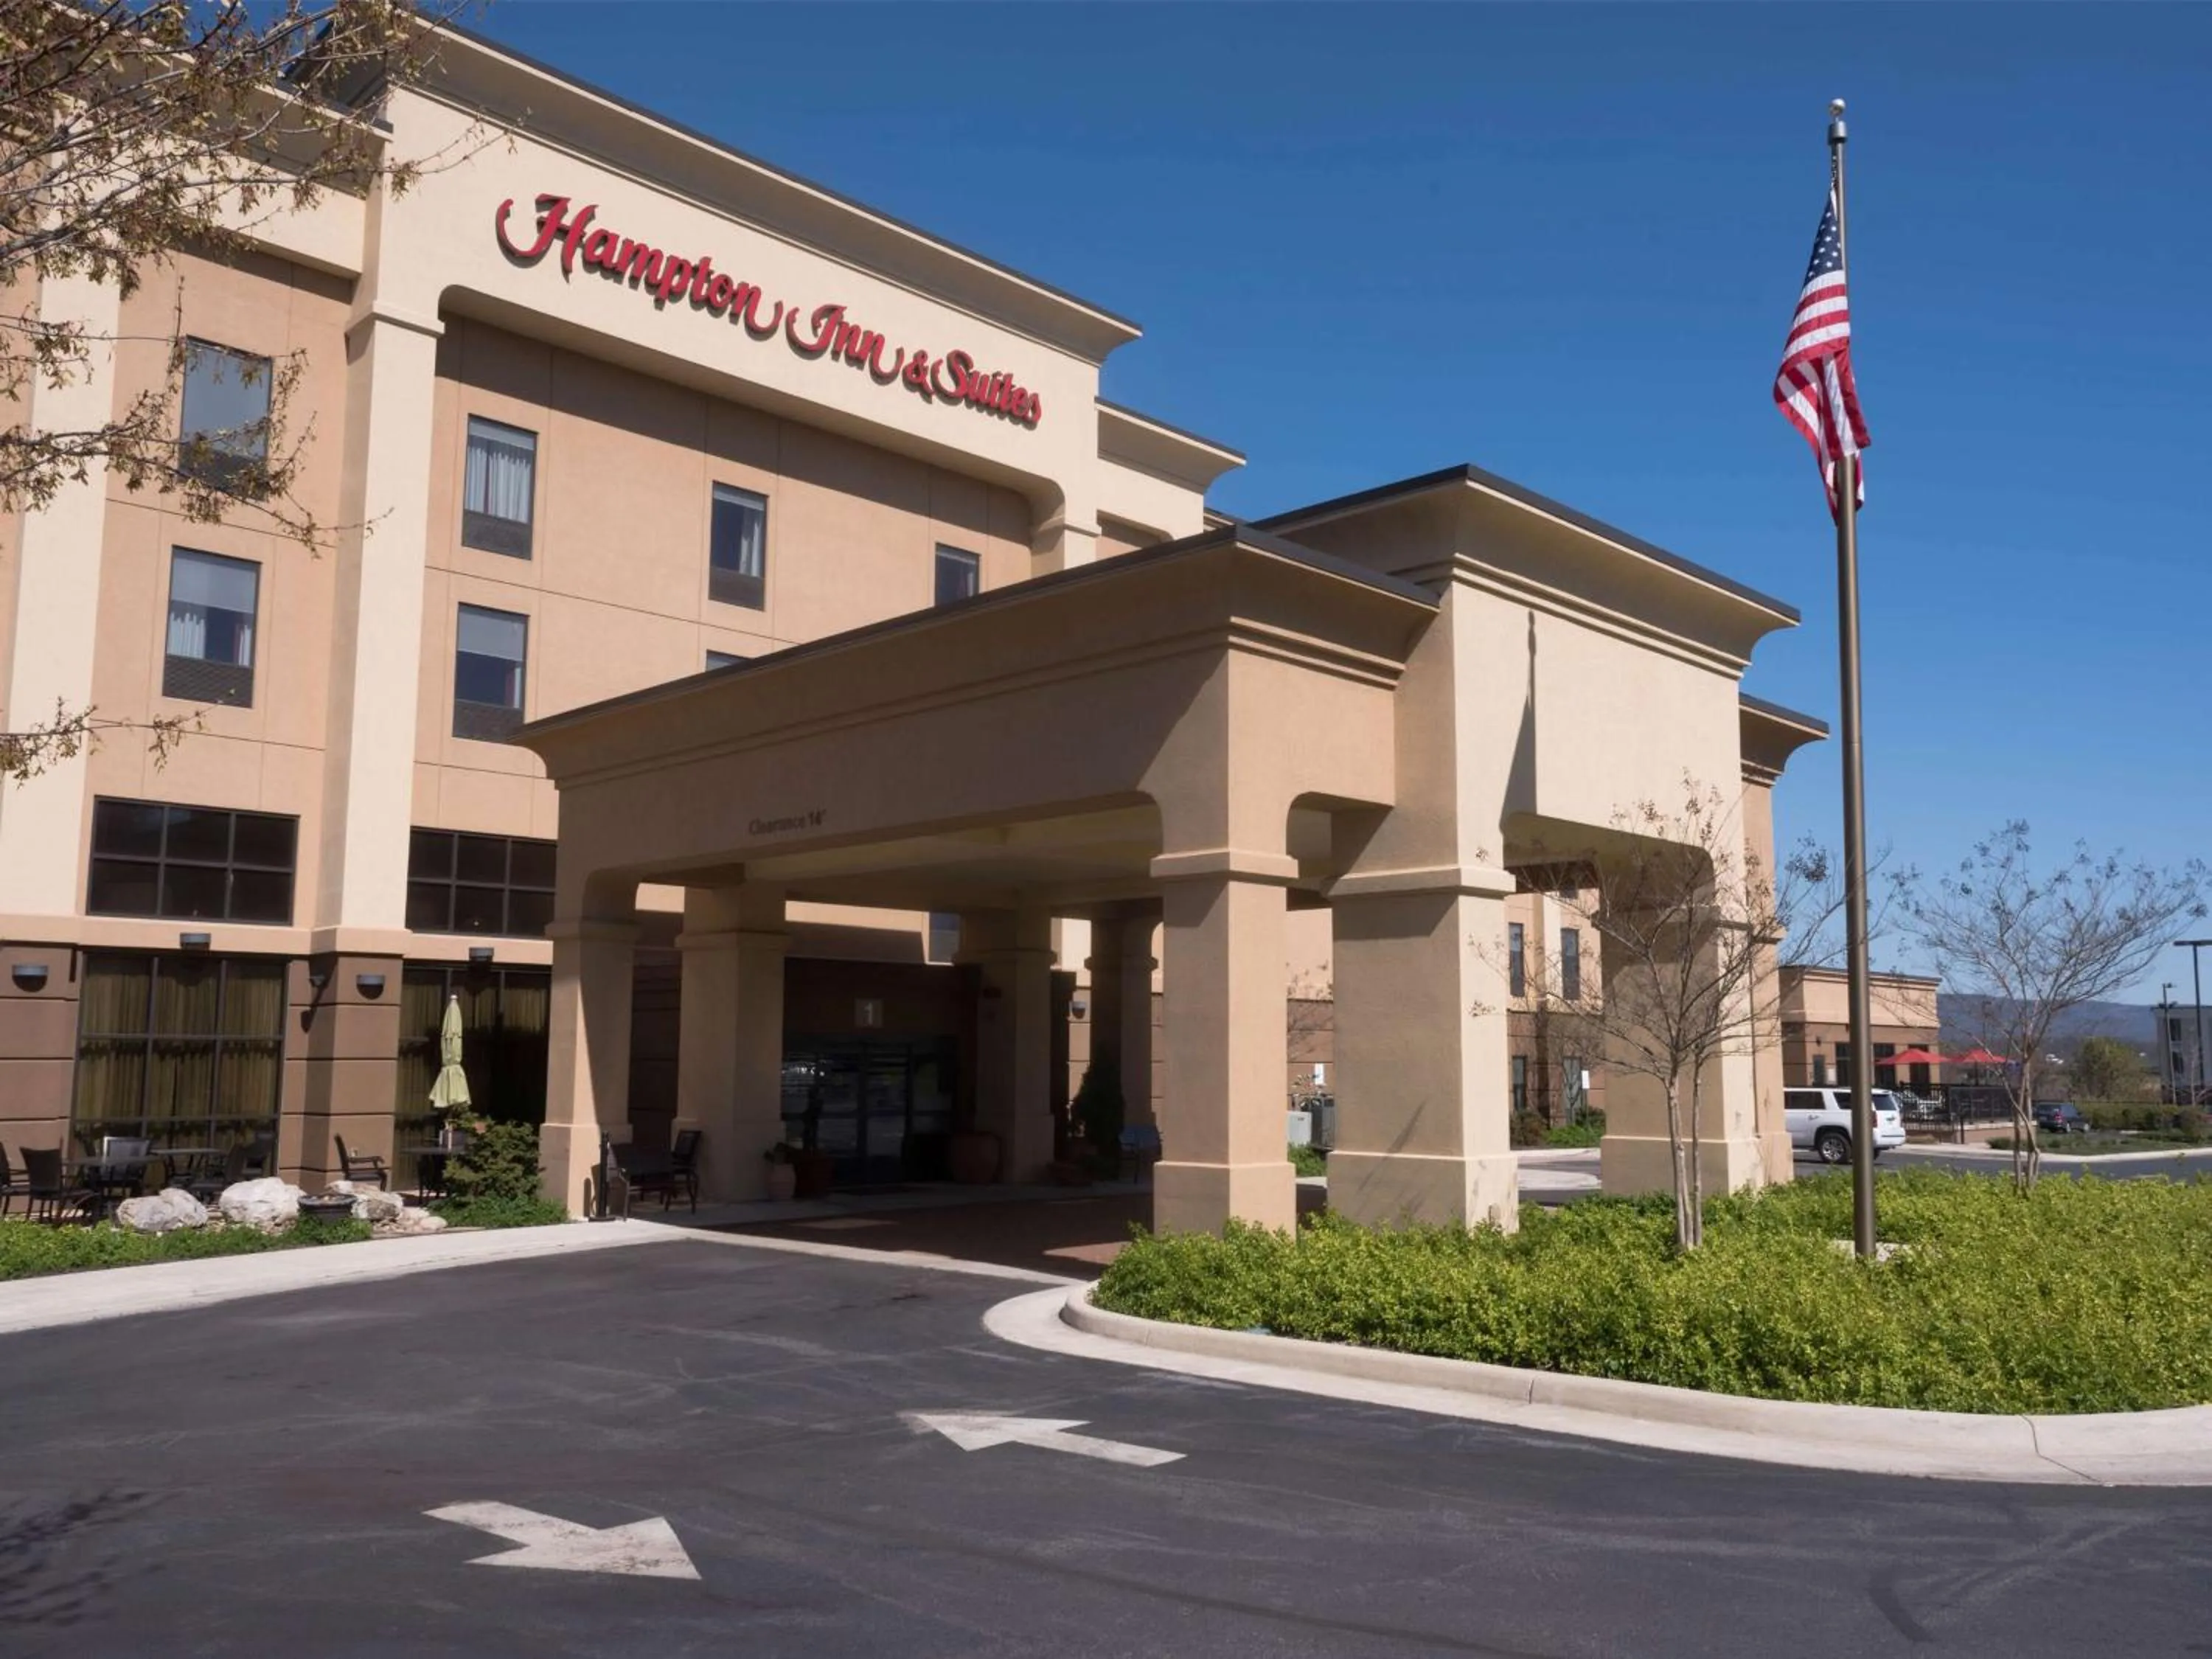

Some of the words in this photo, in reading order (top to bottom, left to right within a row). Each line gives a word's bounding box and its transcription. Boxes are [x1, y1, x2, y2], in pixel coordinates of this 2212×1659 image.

[495, 193, 784, 337] Hampton
[785, 304, 905, 381] Inn
[931, 349, 1042, 428] Suites
